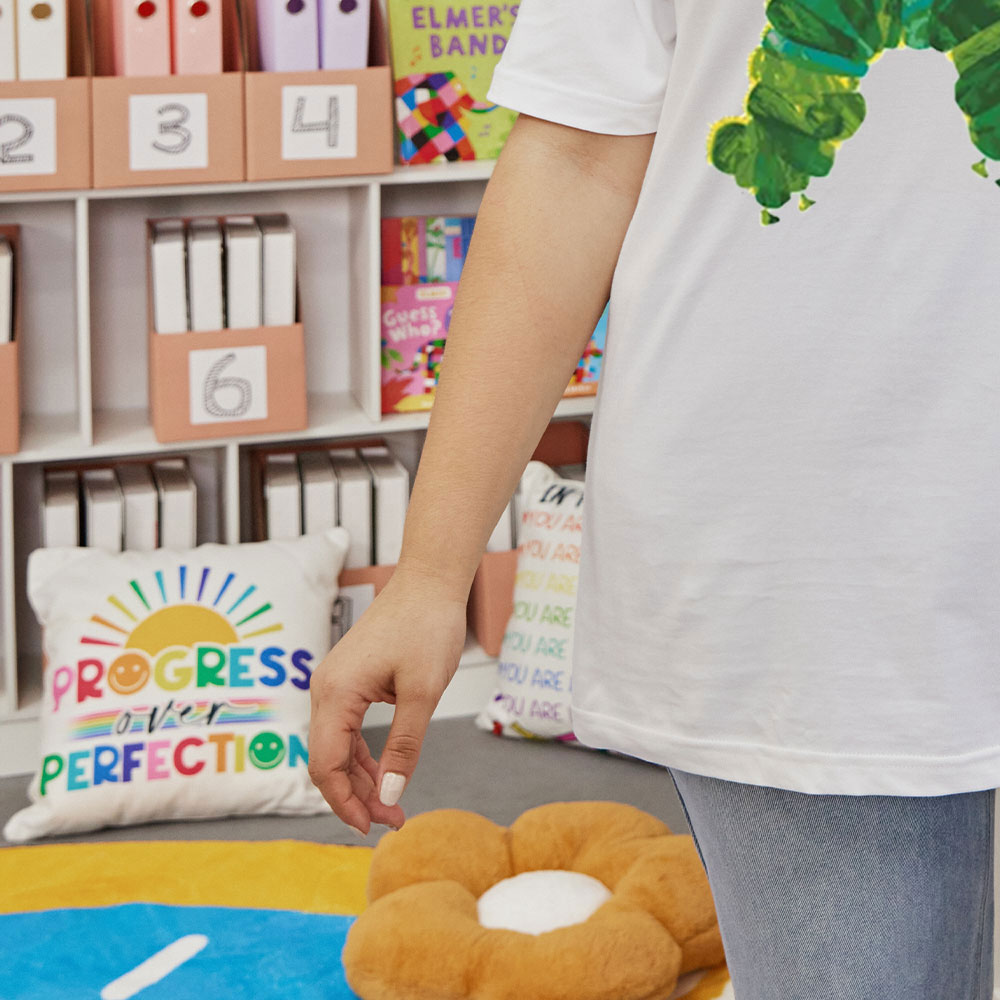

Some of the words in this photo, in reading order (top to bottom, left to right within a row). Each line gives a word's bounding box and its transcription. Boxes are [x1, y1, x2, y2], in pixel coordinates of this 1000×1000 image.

[430, 34, 508, 59] BAND
[152, 102, 193, 154] 3
[291, 95, 340, 148] 4
[204, 352, 252, 418] 6
[115, 699, 230, 736] over
